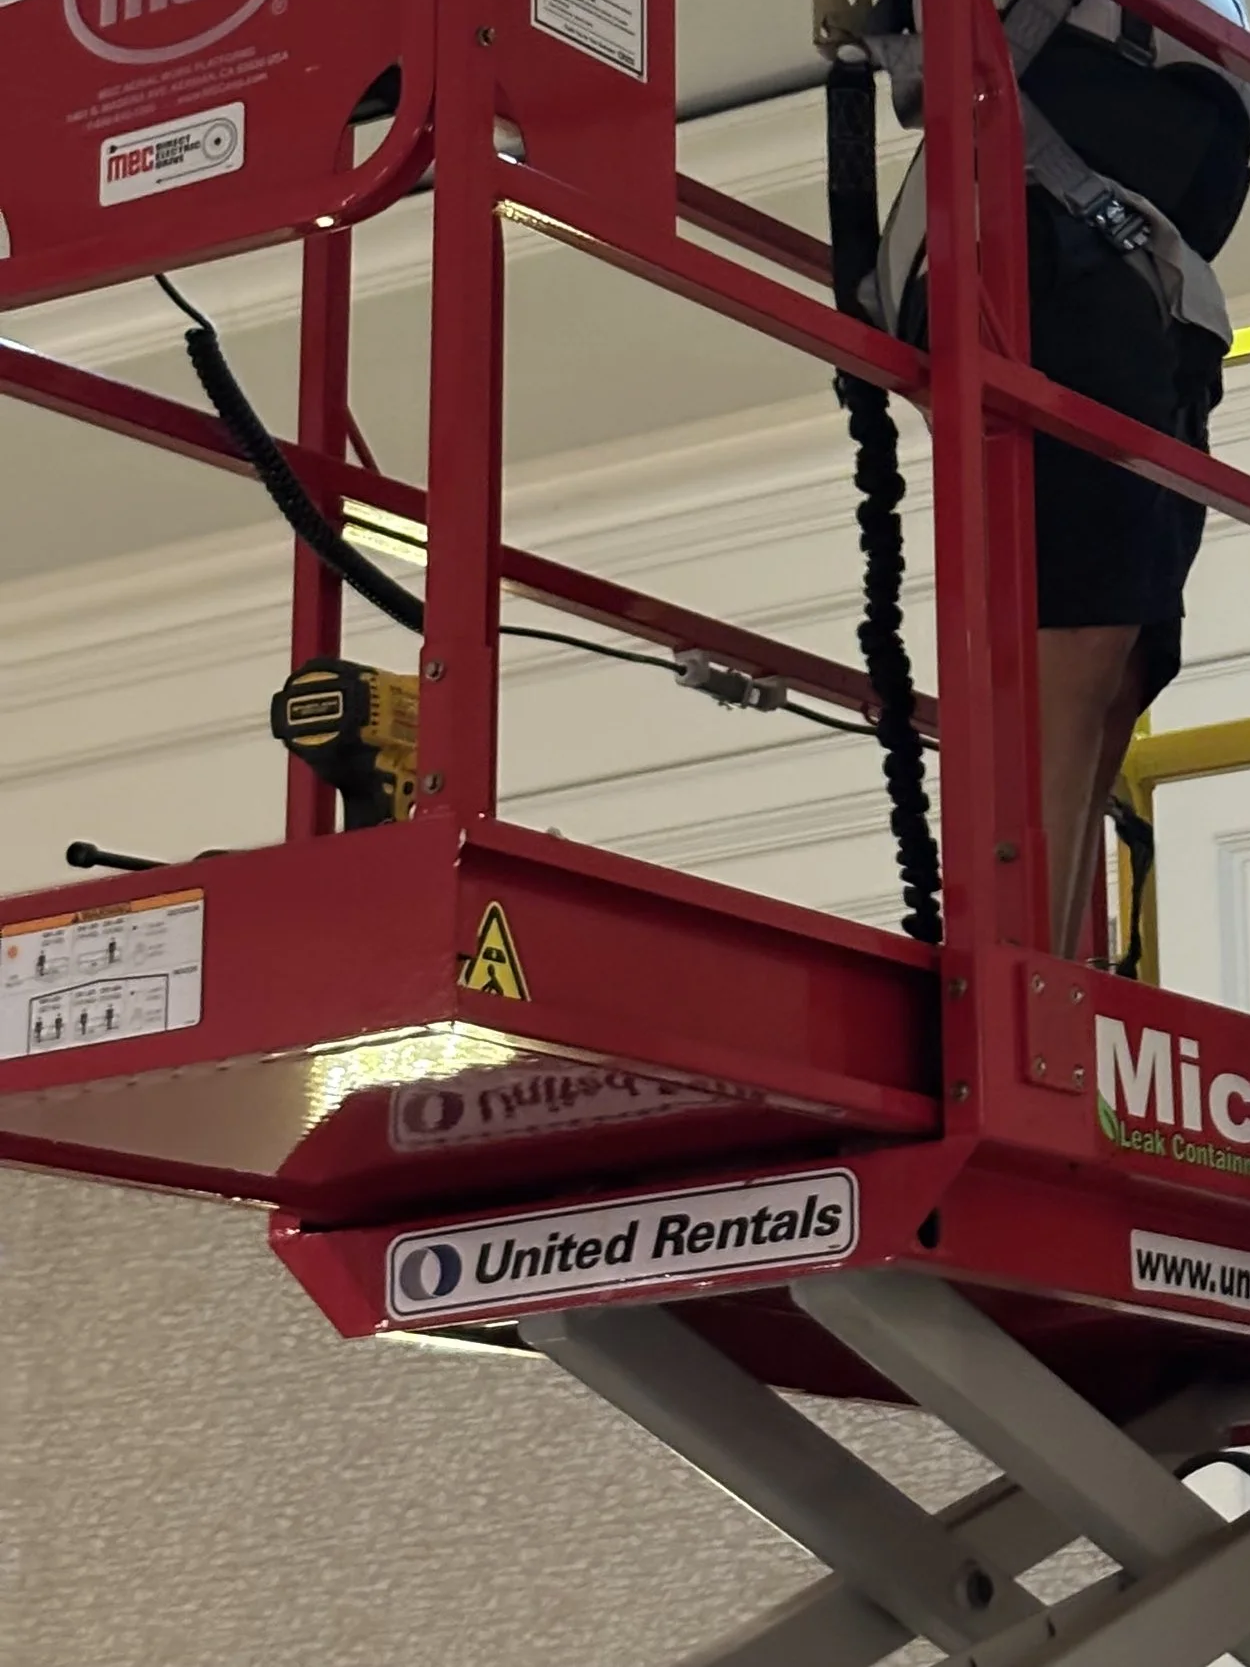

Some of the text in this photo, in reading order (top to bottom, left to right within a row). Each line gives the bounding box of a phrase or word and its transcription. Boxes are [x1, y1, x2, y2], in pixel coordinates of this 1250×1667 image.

[1119, 1120, 1167, 1157] Leak
[474, 1194, 843, 1285] United Rentals
